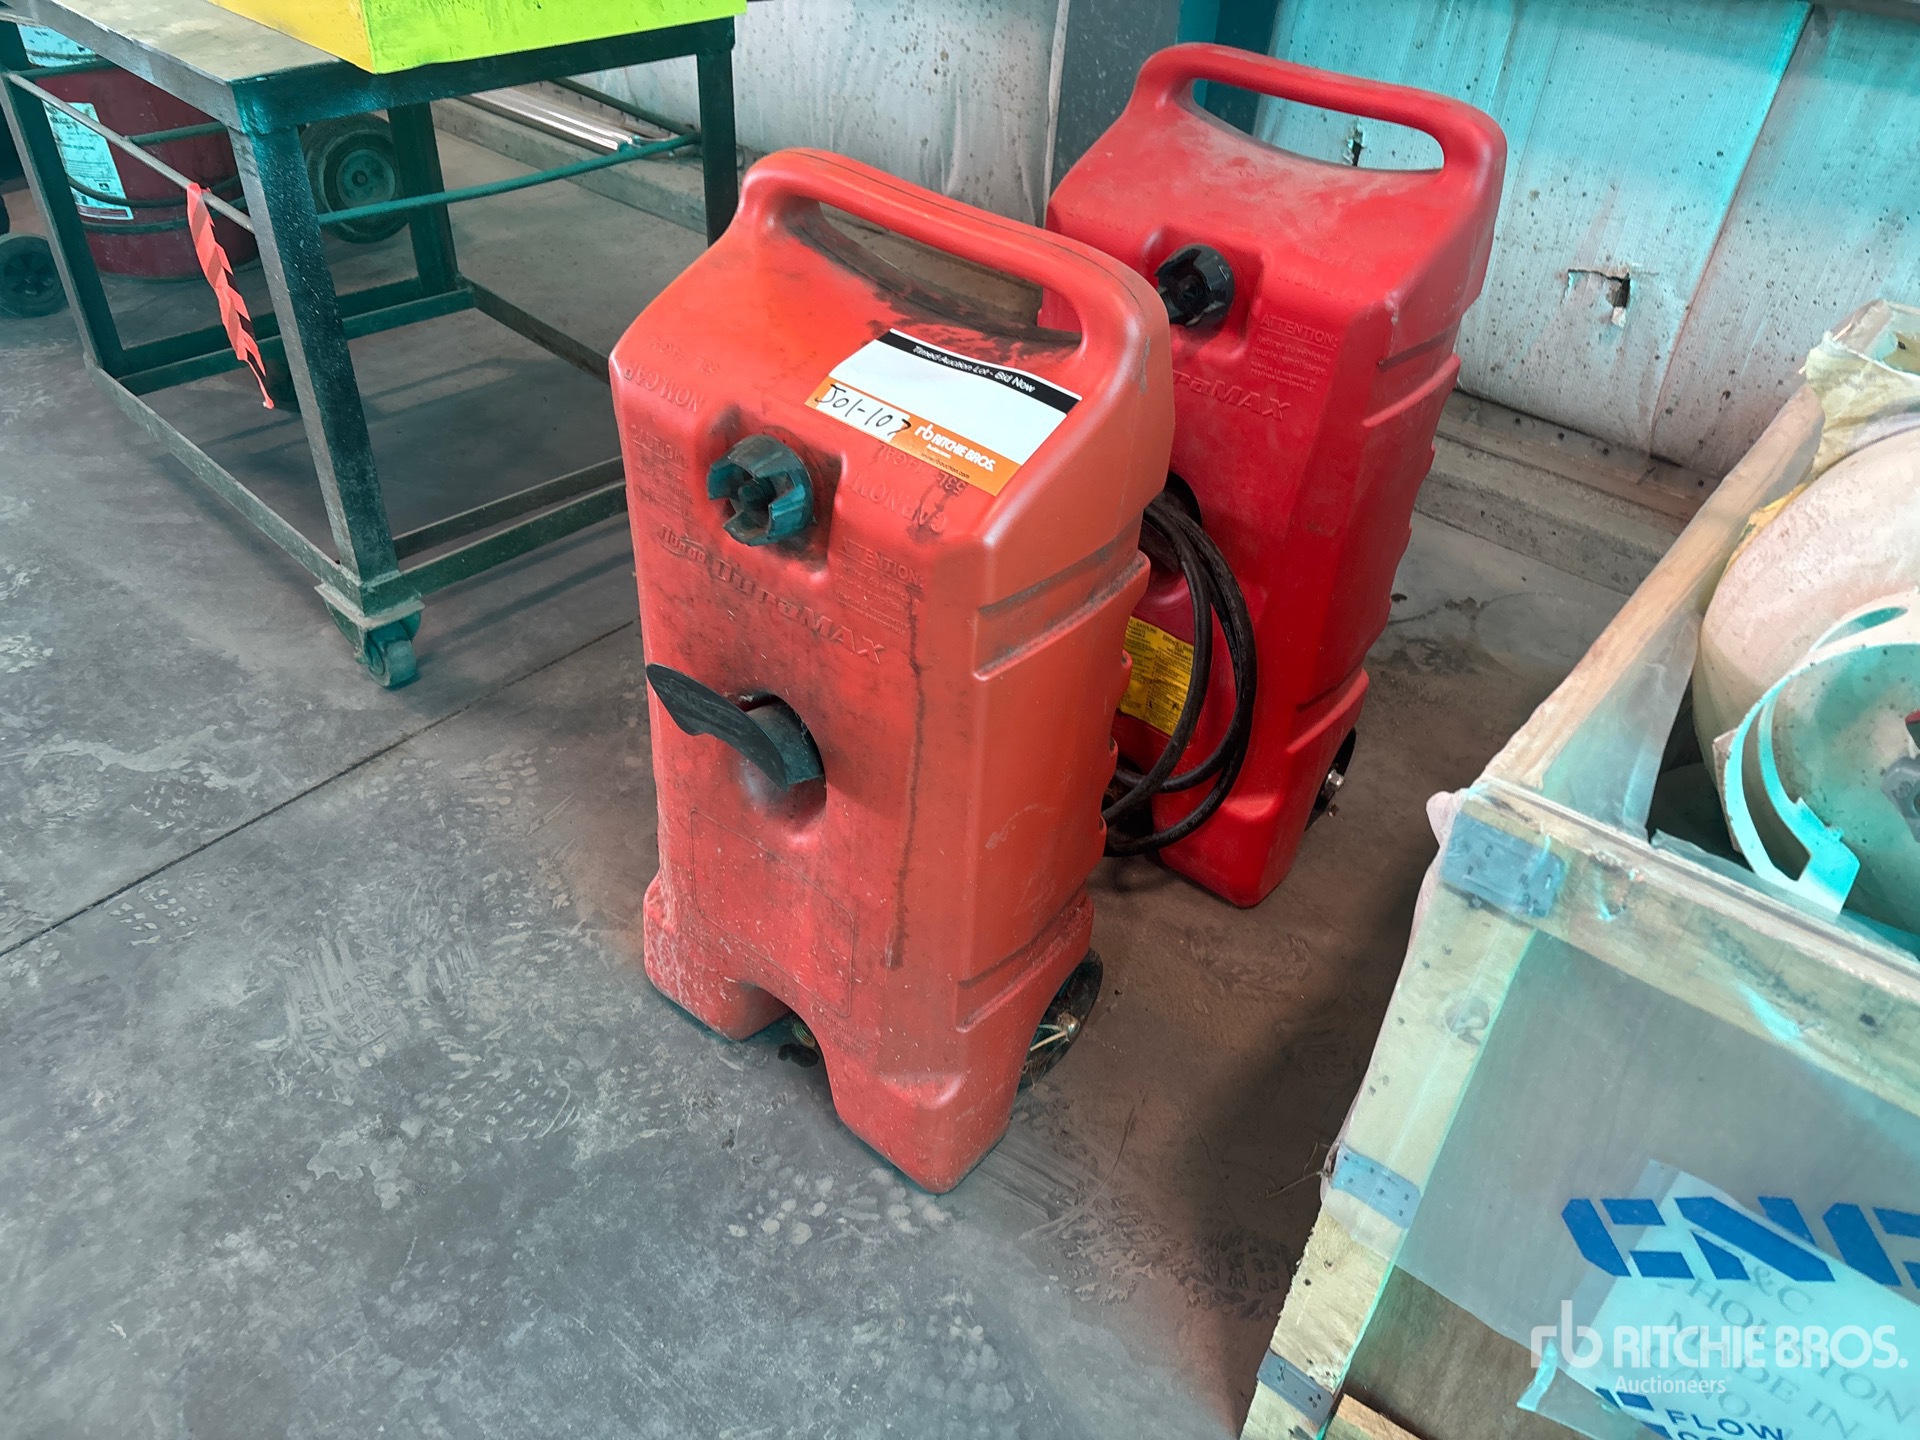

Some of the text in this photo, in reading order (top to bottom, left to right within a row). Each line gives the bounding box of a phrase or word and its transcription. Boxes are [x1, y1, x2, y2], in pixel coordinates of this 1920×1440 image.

[940, 356, 972, 371] Auction
[973, 365, 989, 376] Lot
[994, 371, 1013, 383] Bid
[1011, 376, 1036, 393] Now
[1173, 370, 1291, 422] raMAX
[931, 433, 969, 458] RITCHIE
[1665, 1408, 1784, 1440] FLOW
